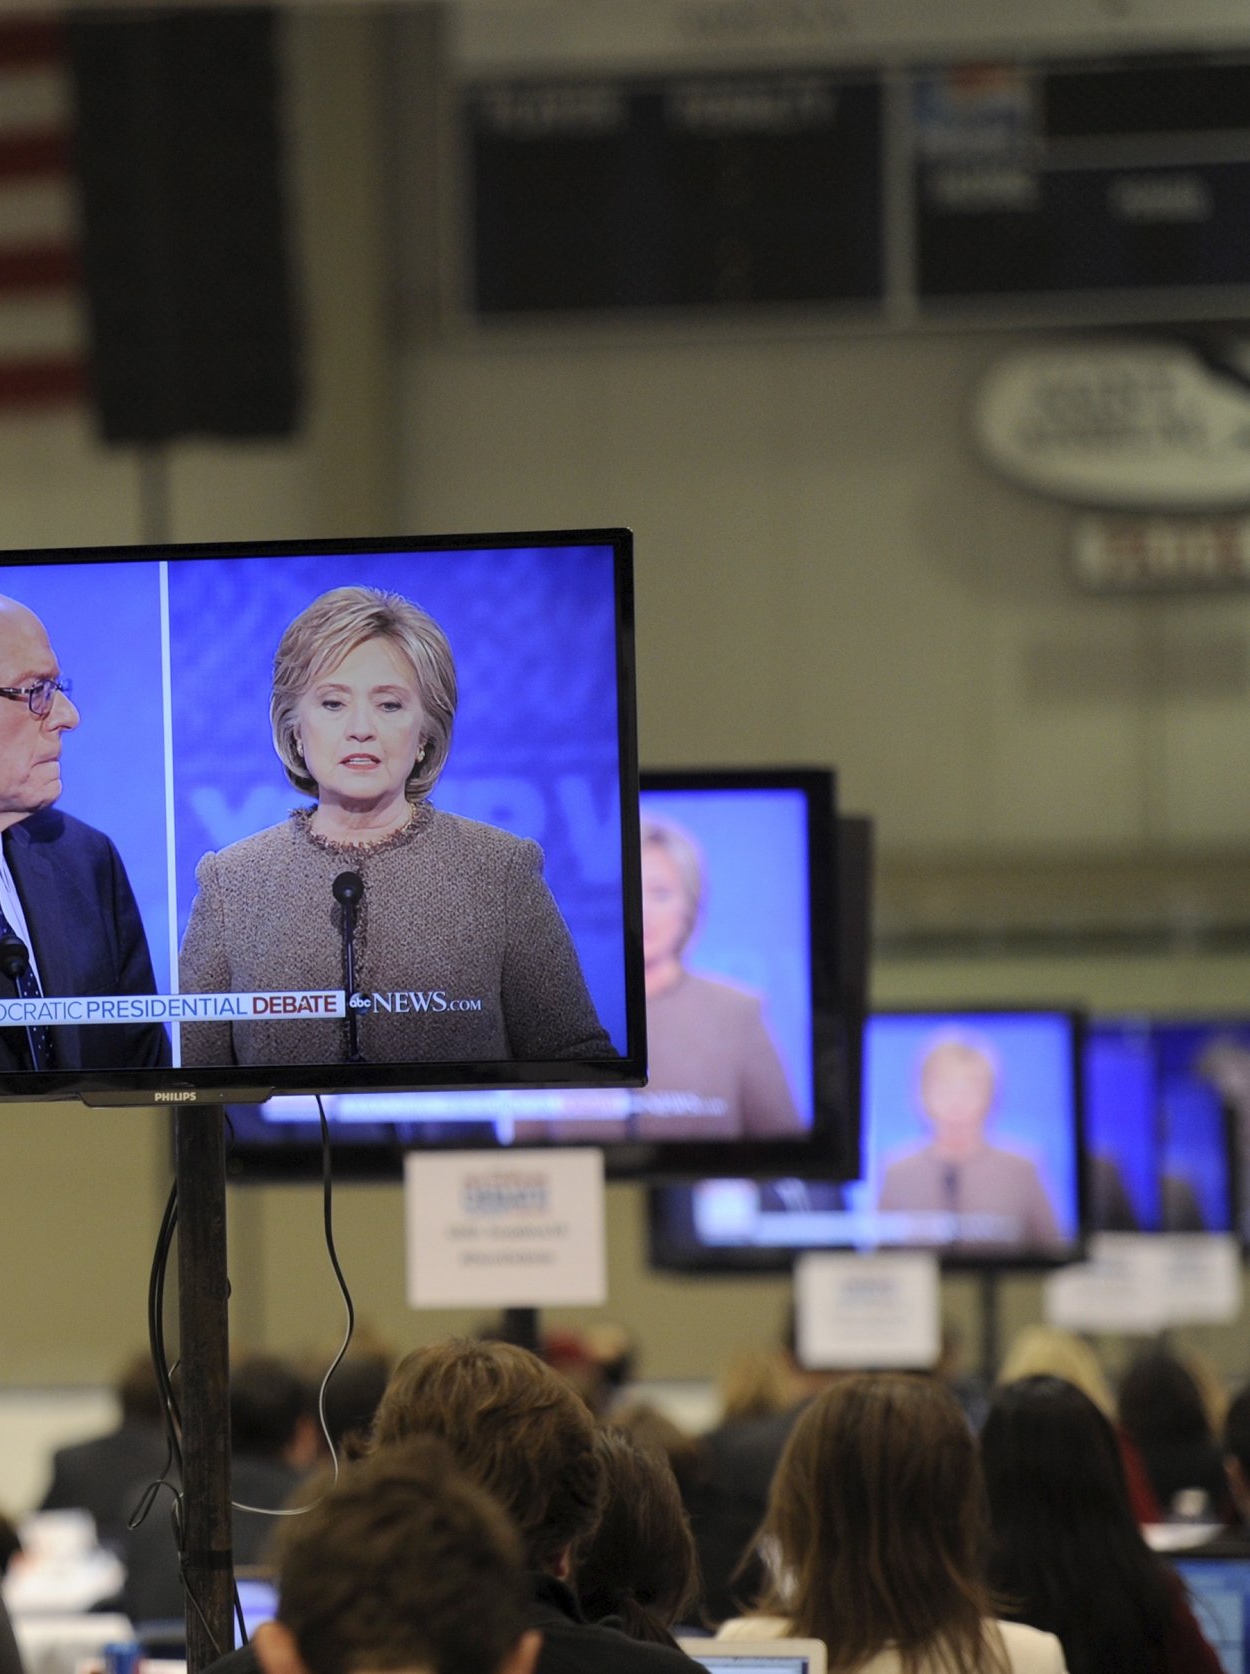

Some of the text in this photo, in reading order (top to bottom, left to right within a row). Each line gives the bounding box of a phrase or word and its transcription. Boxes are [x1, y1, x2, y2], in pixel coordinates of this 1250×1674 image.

[86, 997, 247, 1019] PRESIDENTIAL
[253, 995, 336, 1015] DEBATE
[154, 1092, 197, 1102] PHILIPS
